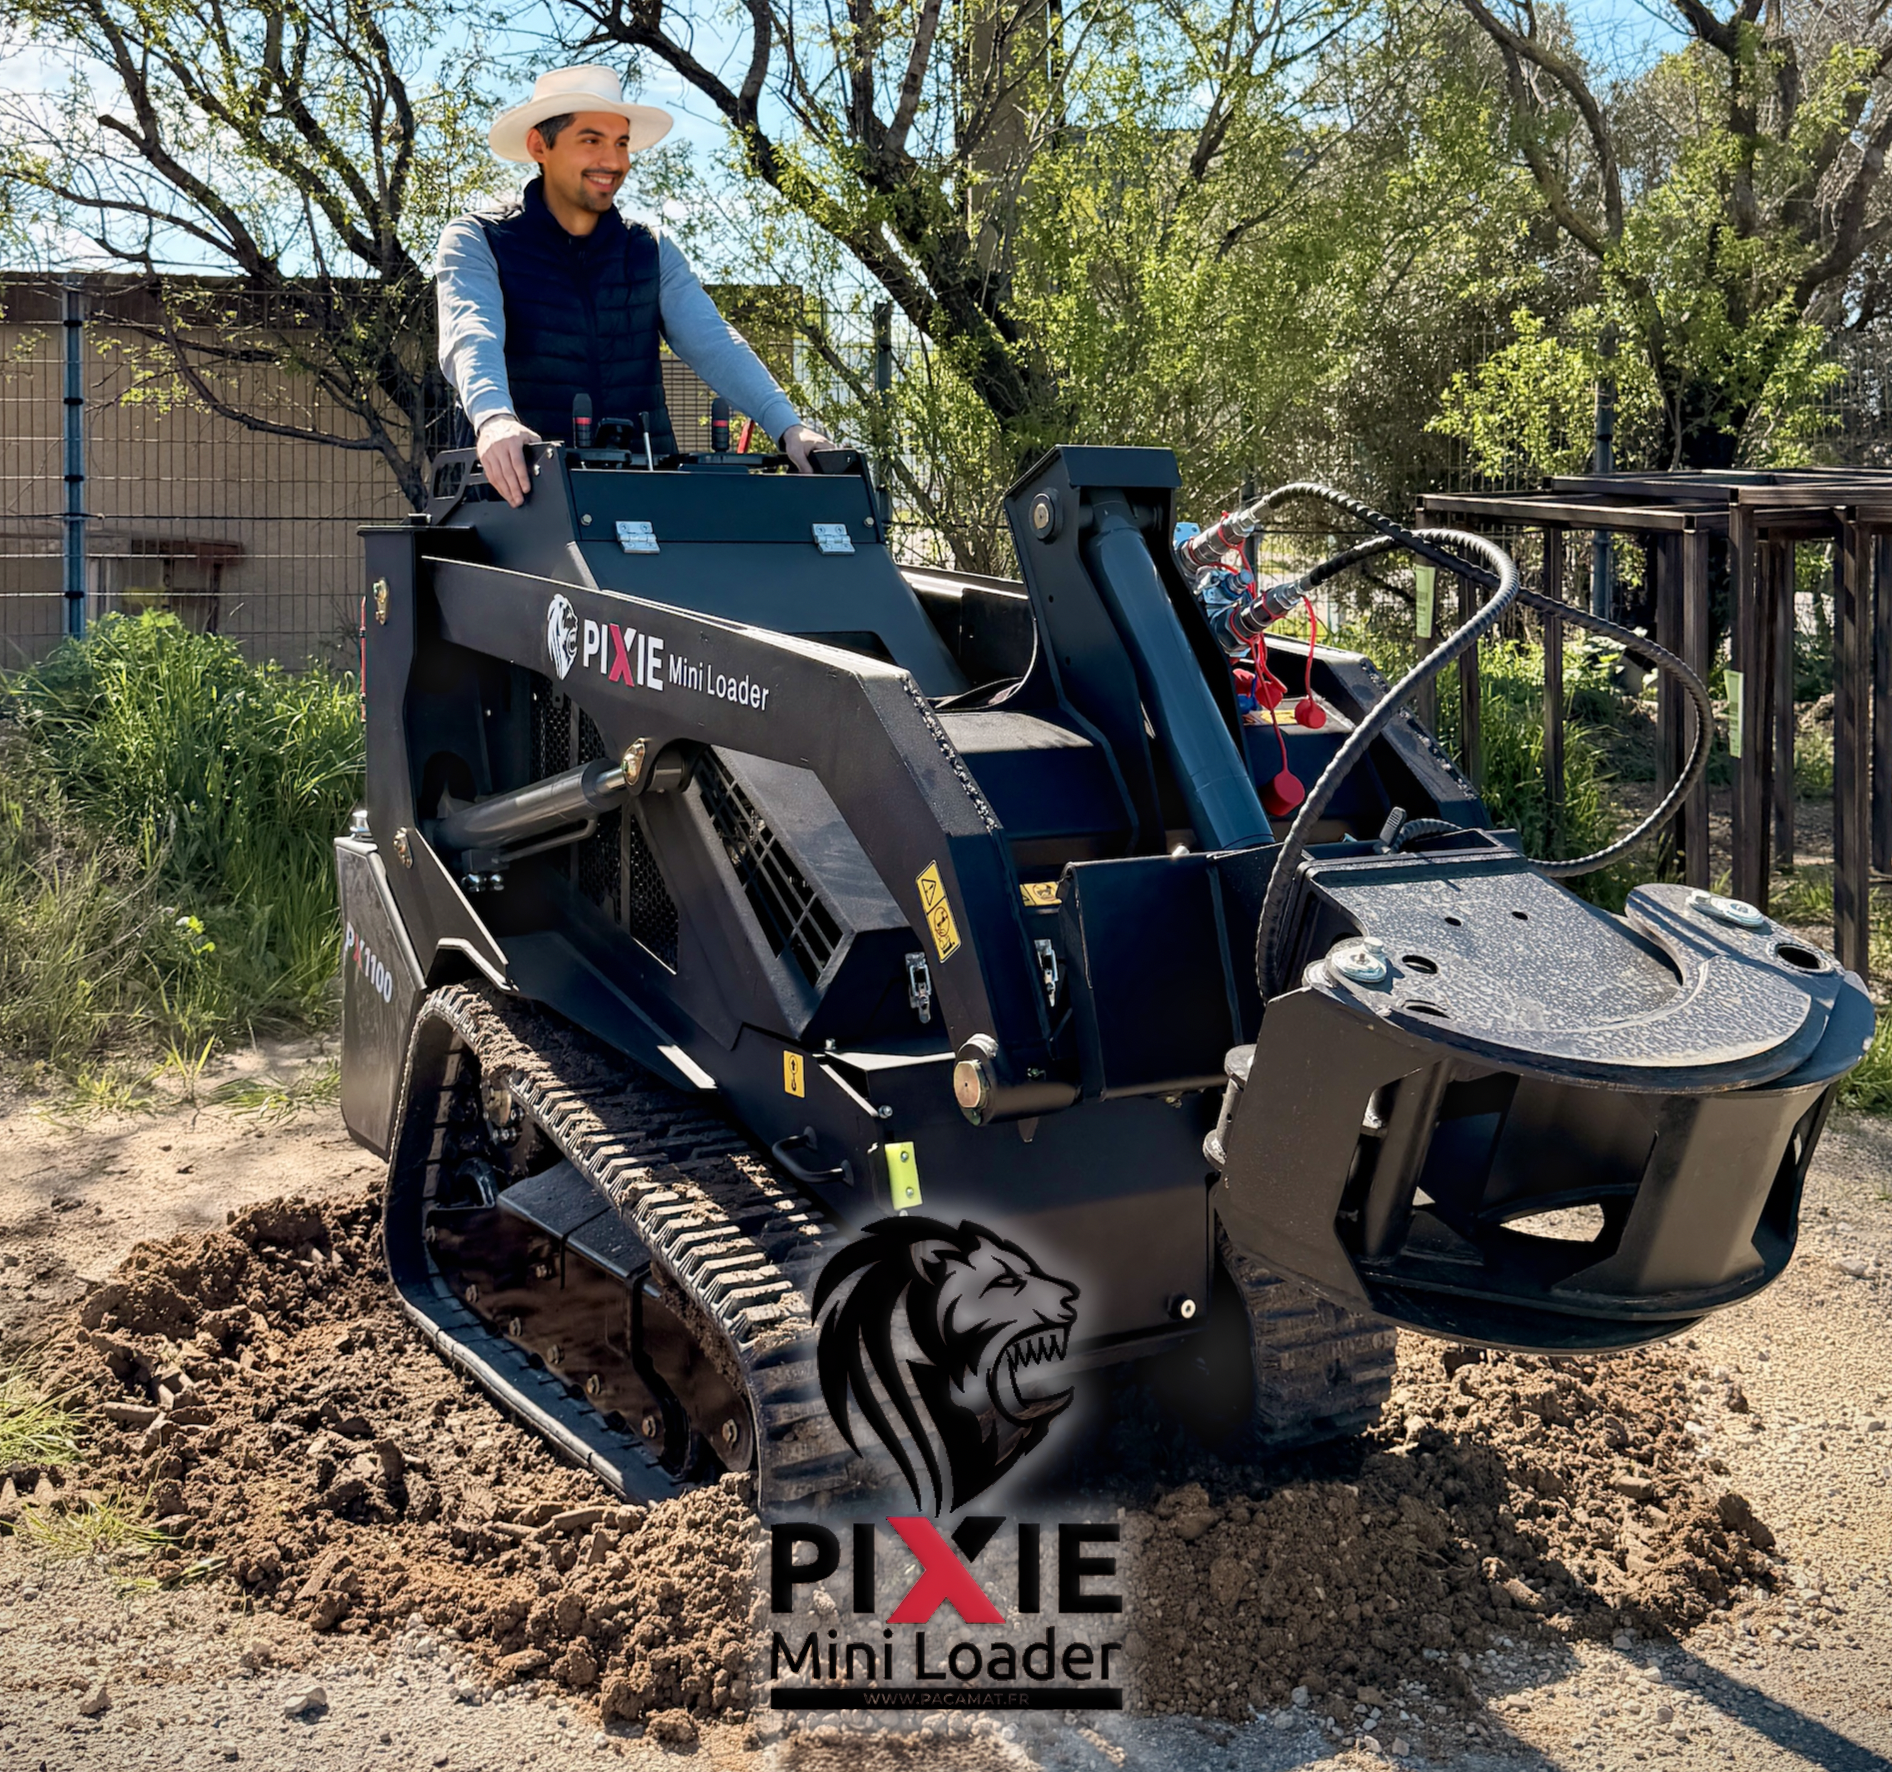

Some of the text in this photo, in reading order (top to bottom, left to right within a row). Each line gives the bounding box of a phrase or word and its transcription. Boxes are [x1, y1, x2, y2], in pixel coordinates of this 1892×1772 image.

[583, 619, 769, 711] PIXIE Mini Loader
